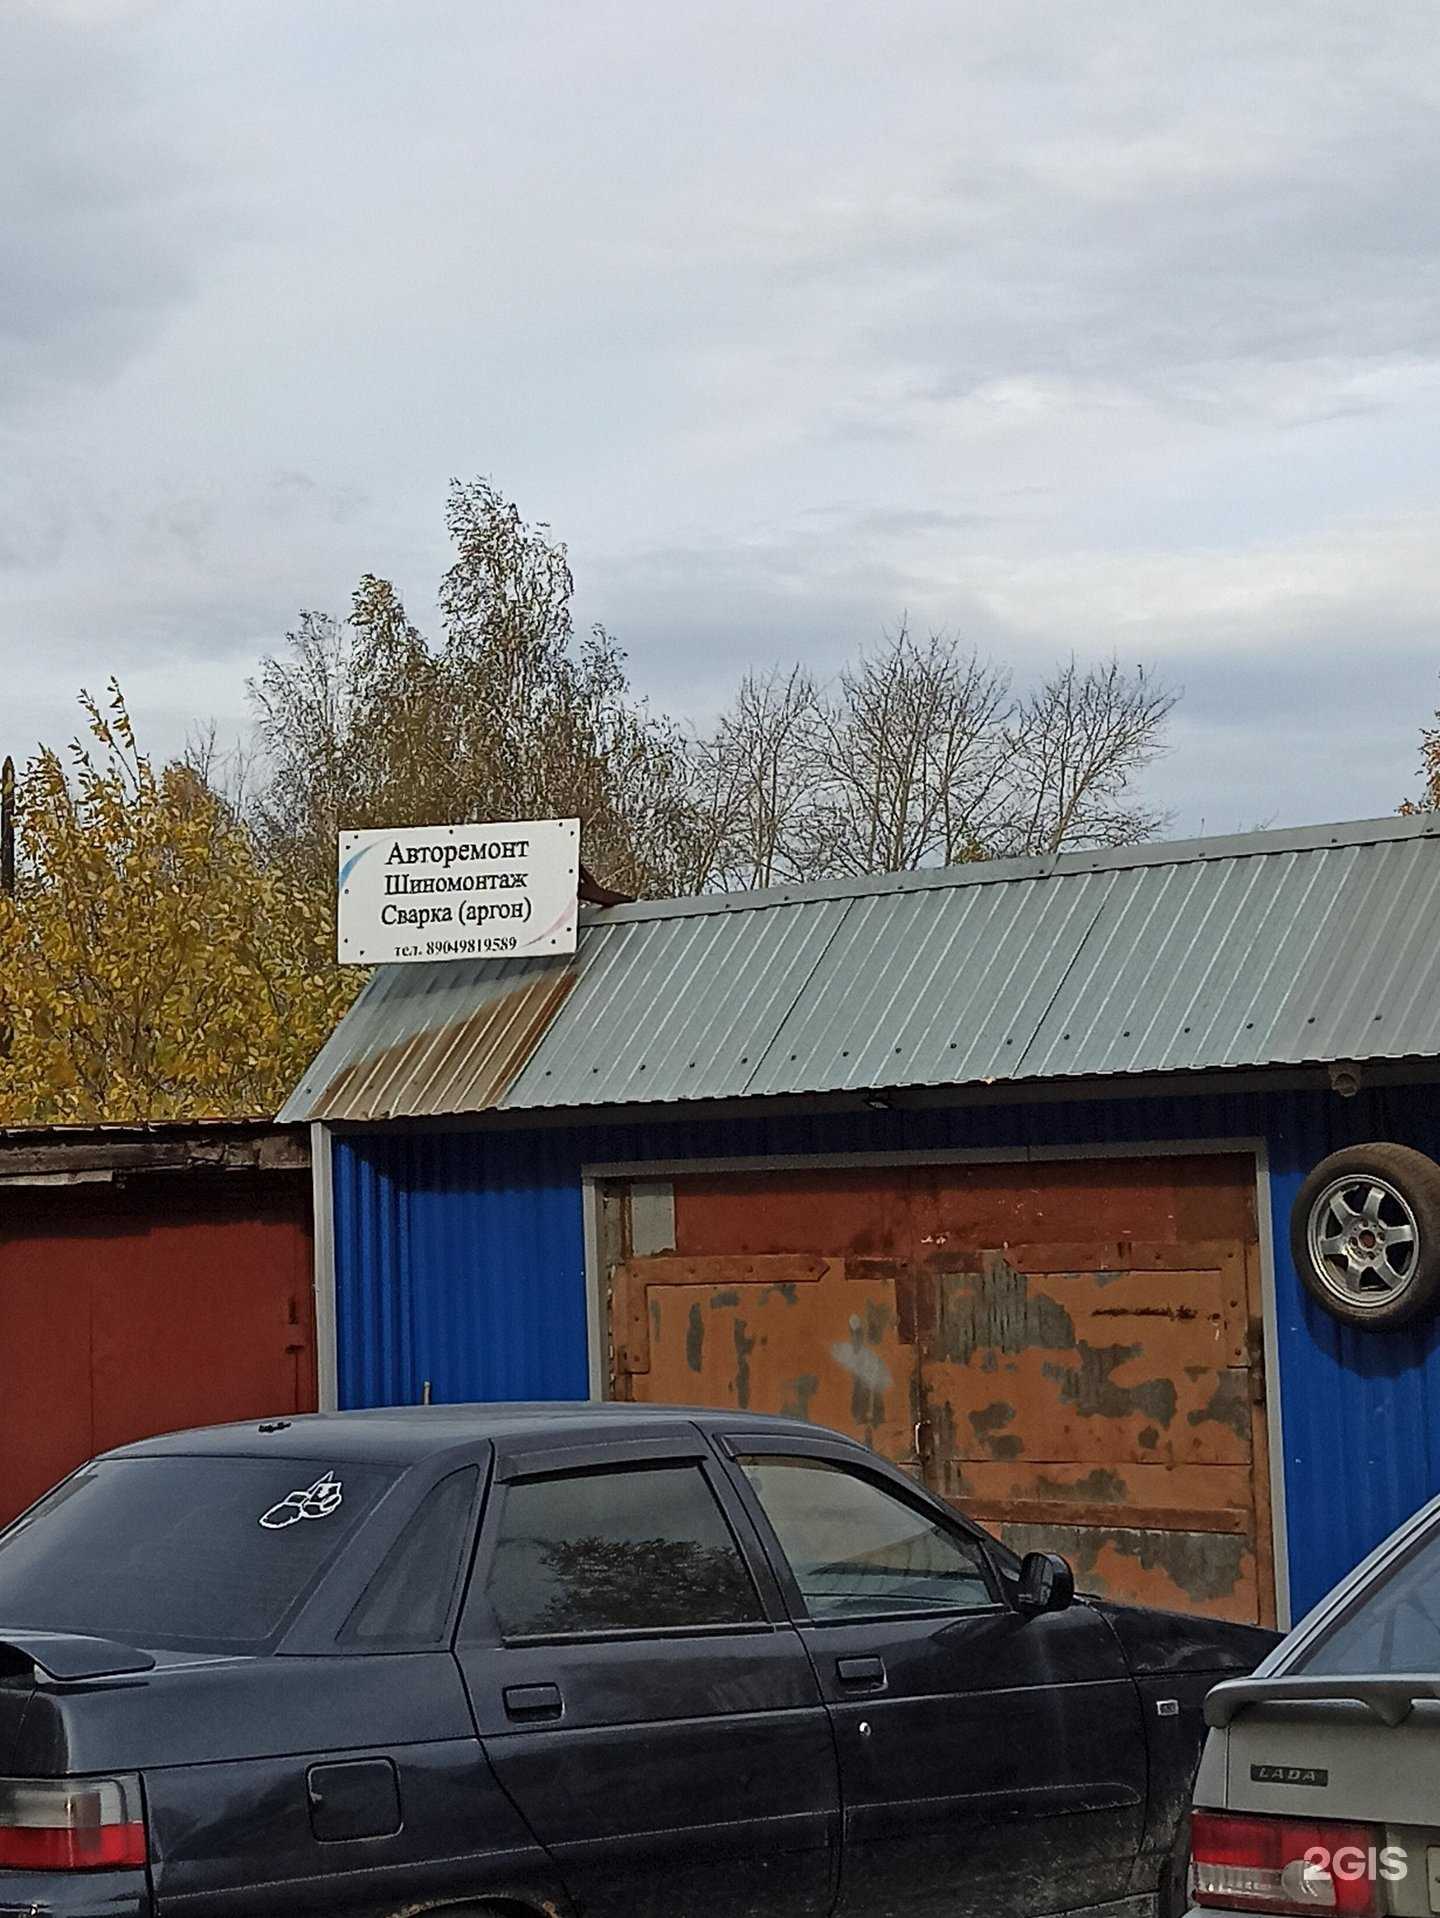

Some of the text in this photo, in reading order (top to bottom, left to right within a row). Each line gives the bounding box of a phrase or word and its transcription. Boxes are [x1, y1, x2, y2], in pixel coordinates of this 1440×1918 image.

[384, 840, 530, 868] Авторемонт
[383, 872, 528, 895] Шиномонтаж
[381, 897, 532, 929] Сварка (аргон)
[395, 937, 517, 957] тел. 89049819589
[1259, 1768, 1317, 1782] LADA
